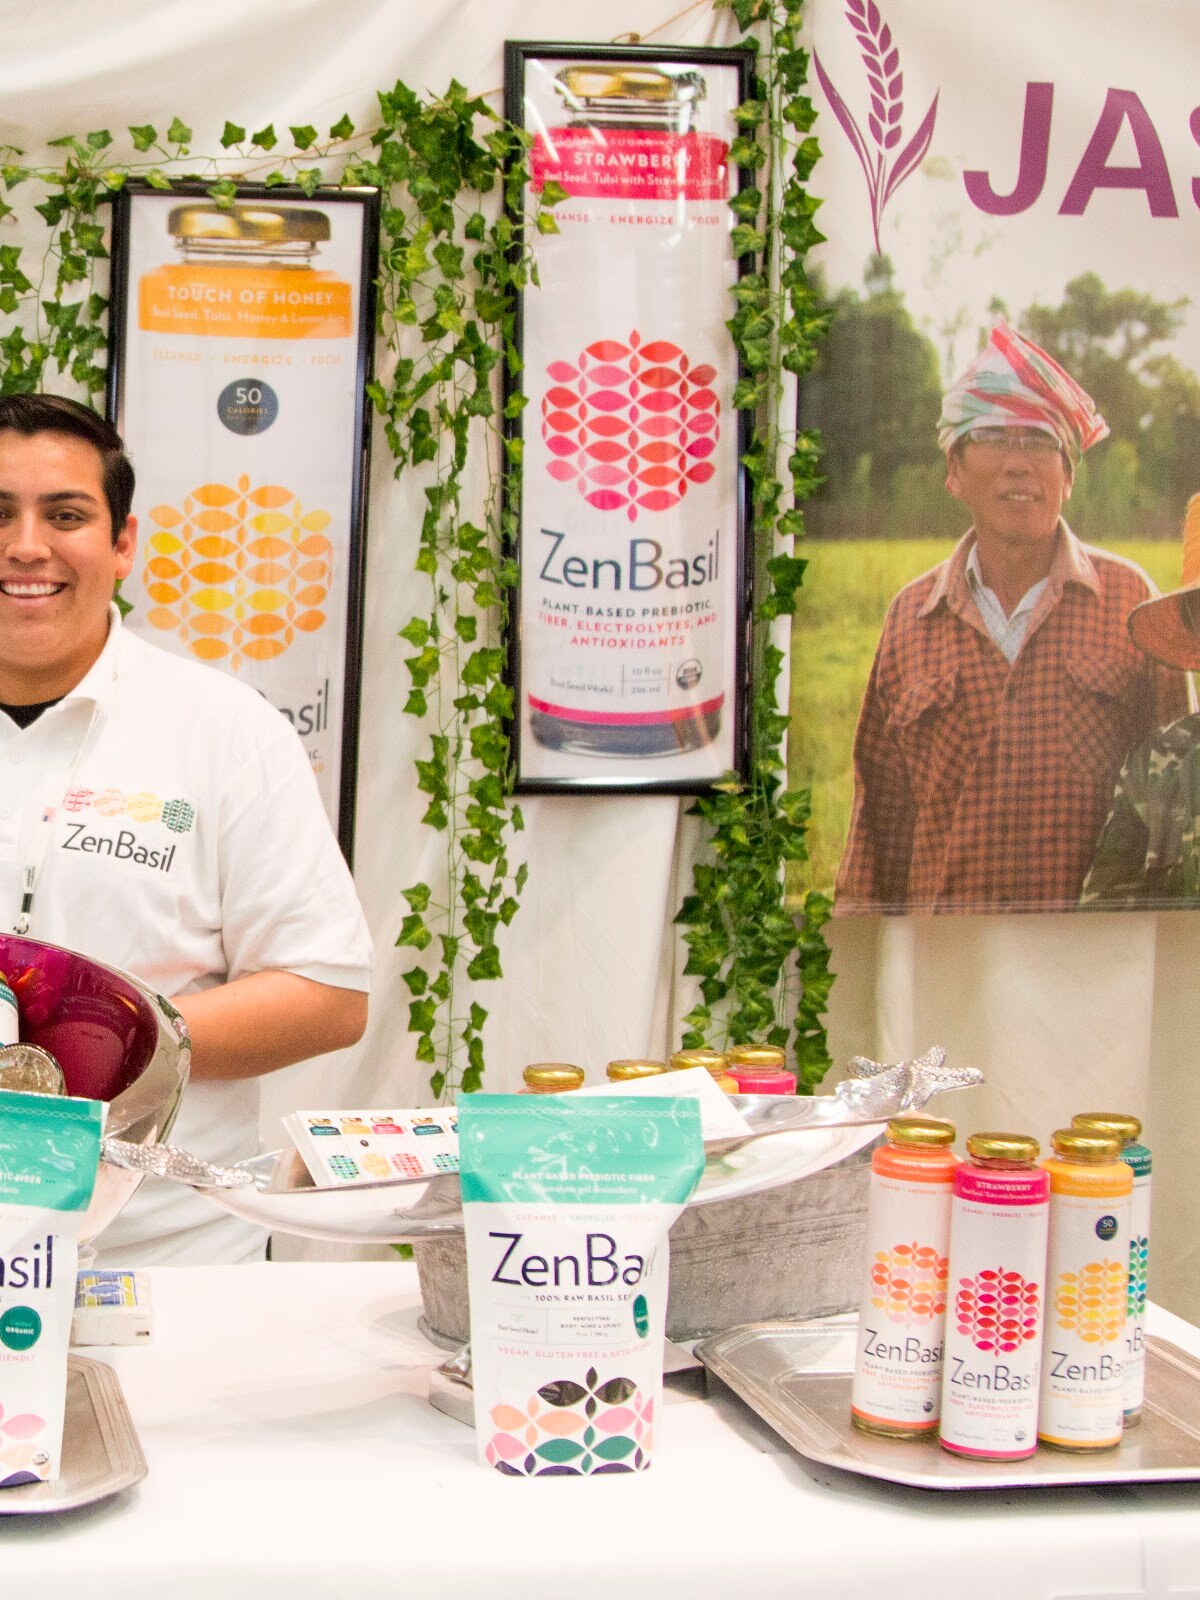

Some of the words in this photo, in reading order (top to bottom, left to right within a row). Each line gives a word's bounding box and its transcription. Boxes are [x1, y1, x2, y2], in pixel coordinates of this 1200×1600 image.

[963, 81, 1200, 219] JA
[593, 174, 618, 184] Tulsi
[621, 174, 644, 184] with
[610, 215, 673, 225] ENERGIZE
[167, 285, 232, 302] TOUCH
[240, 287, 269, 303] OF
[273, 290, 334, 305] HONEY
[238, 310, 278, 324] Honey
[235, 387, 262, 404] 50
[539, 528, 720, 591] ZenBasil
[543, 598, 635, 617] PLANT-BASED
[642, 599, 711, 617] PREBIOTIC
[697, 612, 716, 627] AND
[571, 636, 686, 649] ANTIOXIDANTS
[62, 822, 176, 872] ZenBasil
[629, 1174, 656, 1182] FIBER
[976, 1181, 1032, 1191] STRAWBERRY
[1103, 1219, 1113, 1227] 50
[535, 1294, 561, 1302] 100%
[564, 1294, 584, 1302] RAW
[5, 1326, 35, 1335] ORGANIC
[498, 1346, 532, 1357] VEGAN,
[535, 1349, 574, 1359] GLUTEN
[576, 1351, 600, 1359] FREE
